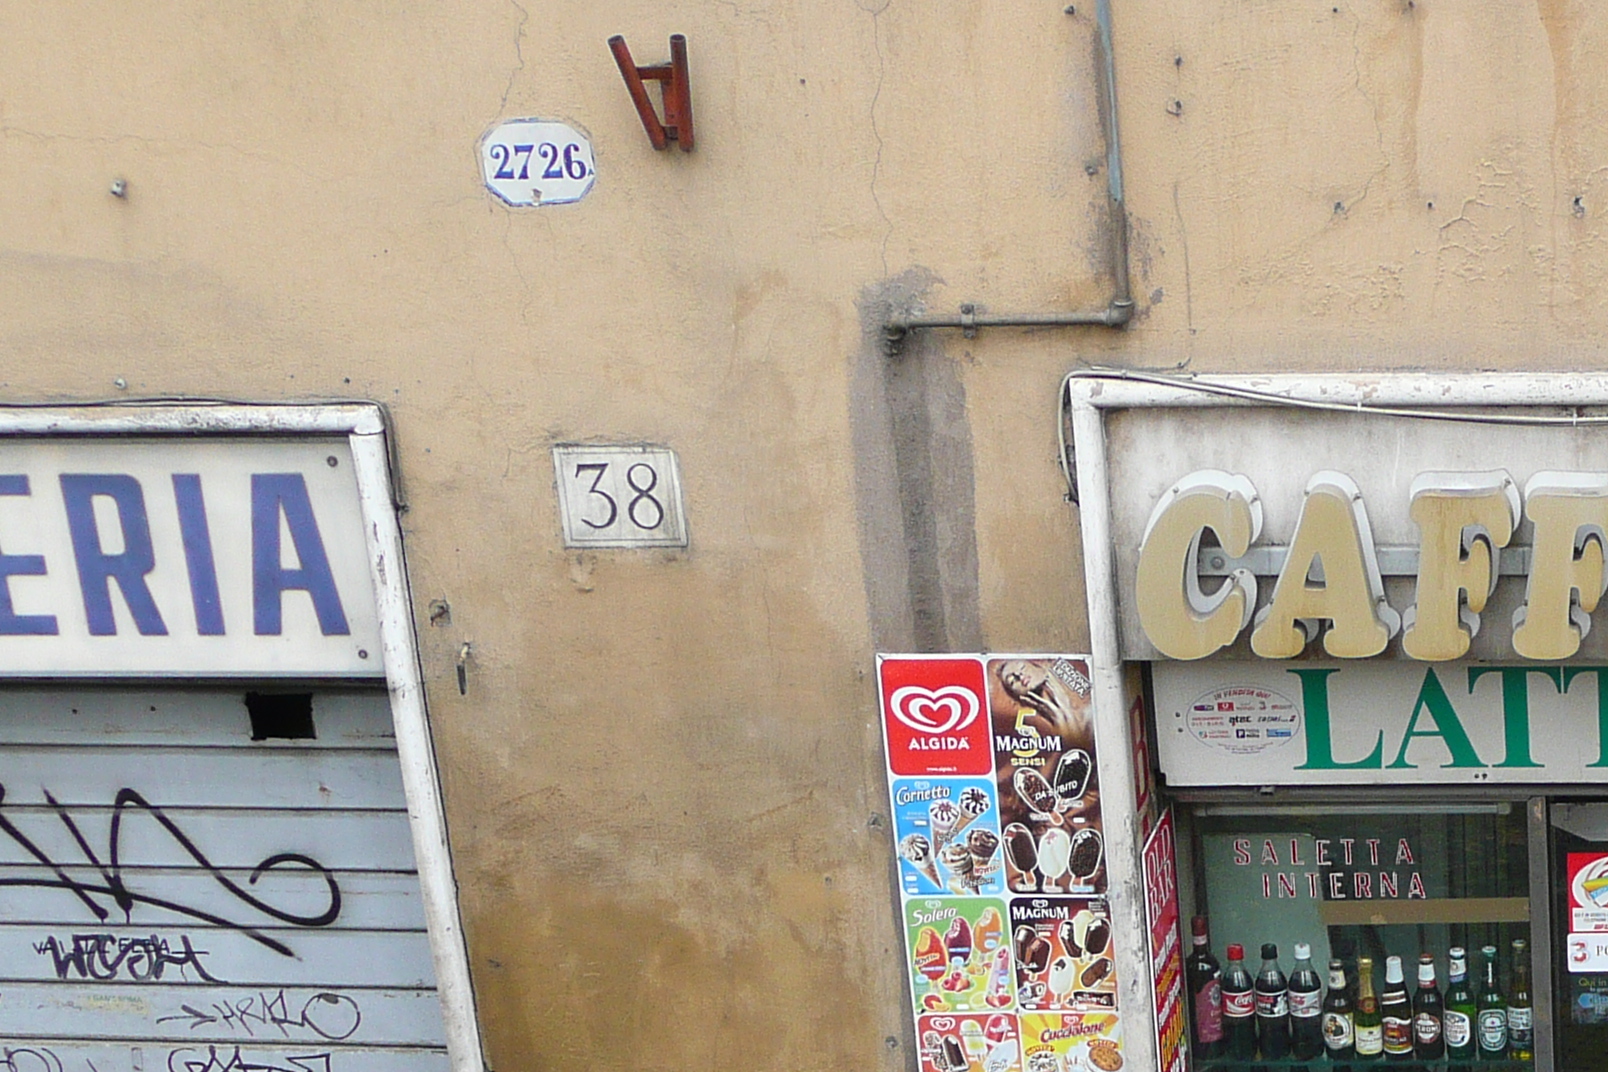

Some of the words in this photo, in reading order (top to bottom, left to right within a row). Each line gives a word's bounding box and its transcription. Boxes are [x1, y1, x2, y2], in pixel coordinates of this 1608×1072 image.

[489, 142, 586, 180] 2726
[573, 463, 665, 530] 38
[909, 737, 969, 750] ALGIDA
[995, 735, 1061, 752] MAGNUM
[1011, 758, 1046, 767] SENSI
[896, 786, 951, 806] Cornetto
[1147, 823, 1172, 887] OLD
[1233, 838, 1416, 867] SALETTA
[1149, 862, 1175, 929] BAR
[1261, 871, 1427, 899] INTERNA
[910, 906, 957, 927] Solero
[1012, 905, 1069, 920] MAGNUM
[1570, 941, 1588, 962] 3
[1578, 978, 1597, 987] Qui
[1598, 978, 1606, 986] in
[1040, 1022, 1105, 1042] Cucciolone
